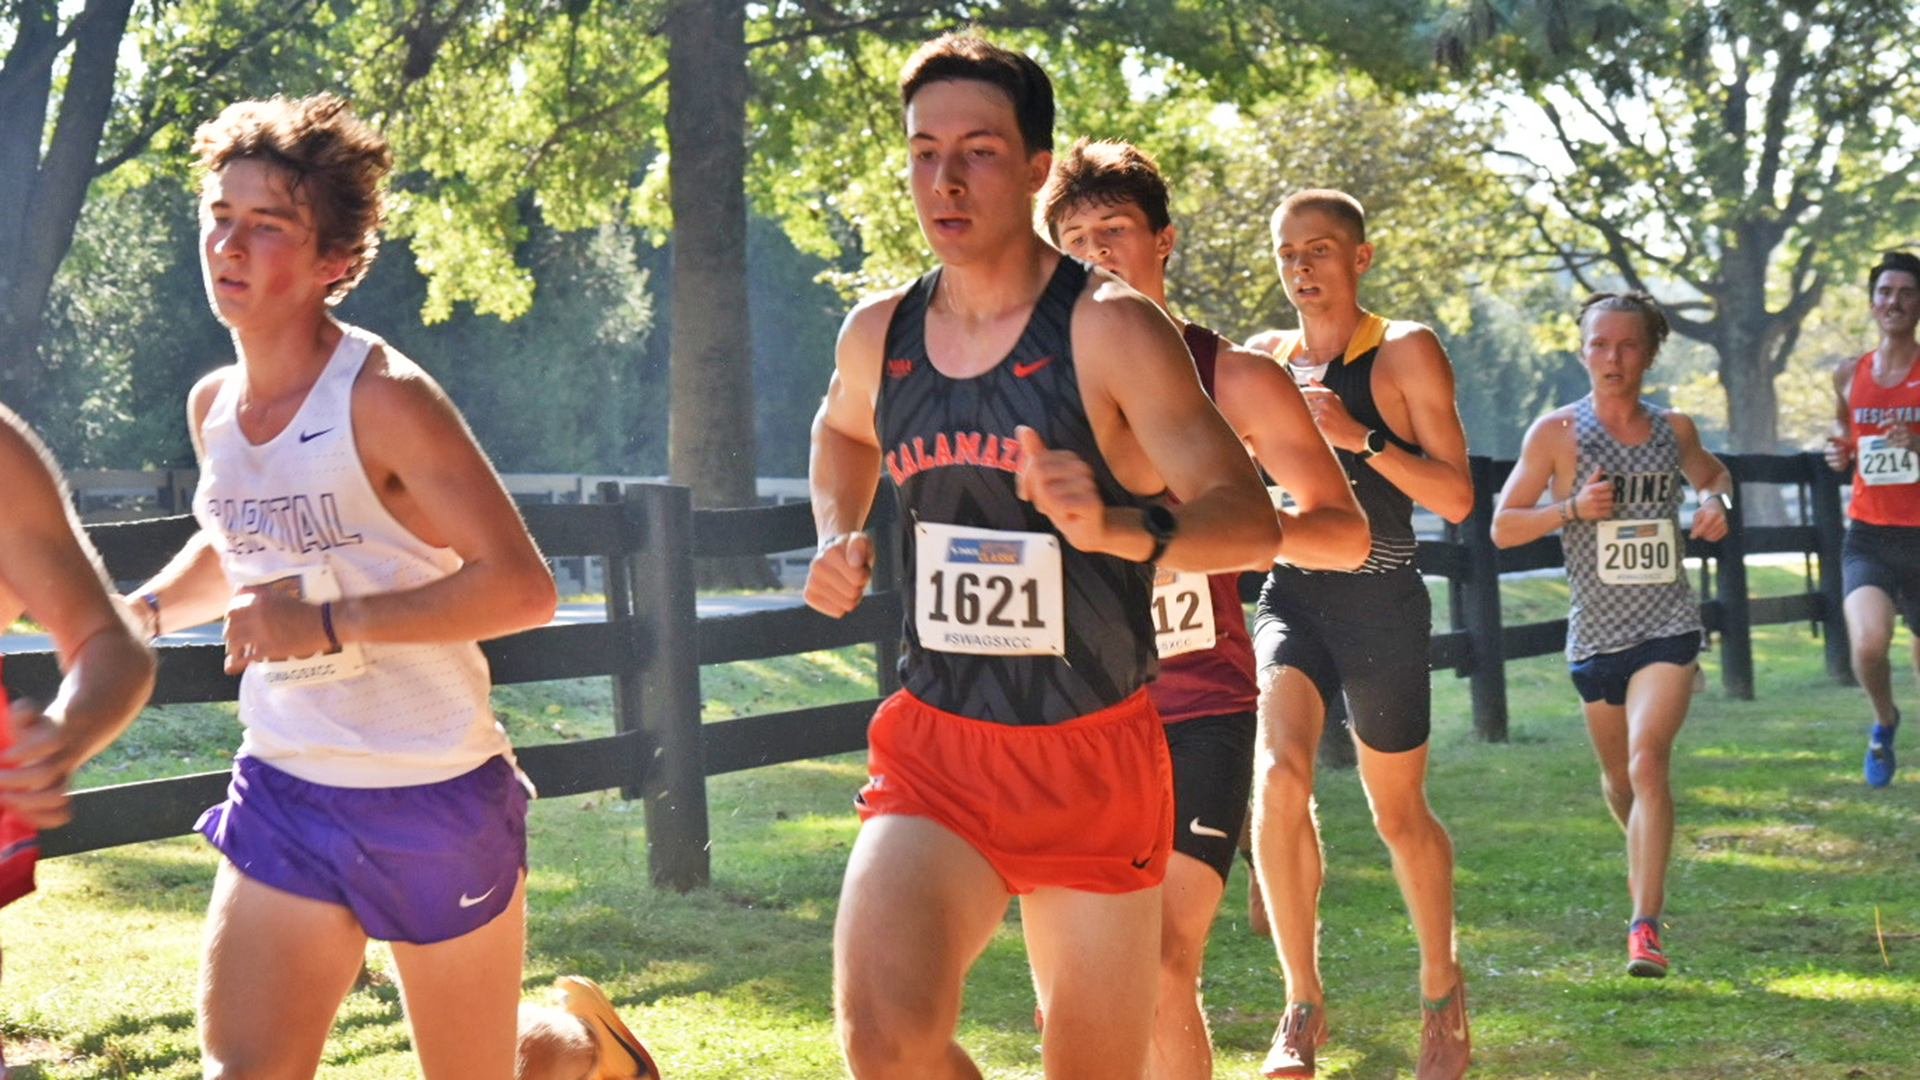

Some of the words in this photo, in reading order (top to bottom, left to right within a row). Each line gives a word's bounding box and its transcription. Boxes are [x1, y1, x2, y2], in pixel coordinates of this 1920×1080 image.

[886, 431, 1022, 487] KALAMAZ
[1863, 451, 1913, 475] 2214
[208, 493, 363, 554] CAPITAL
[1604, 541, 1669, 570] 2090
[928, 569, 1046, 629] 1621
[944, 632, 1033, 649] #SWAGSXCC
